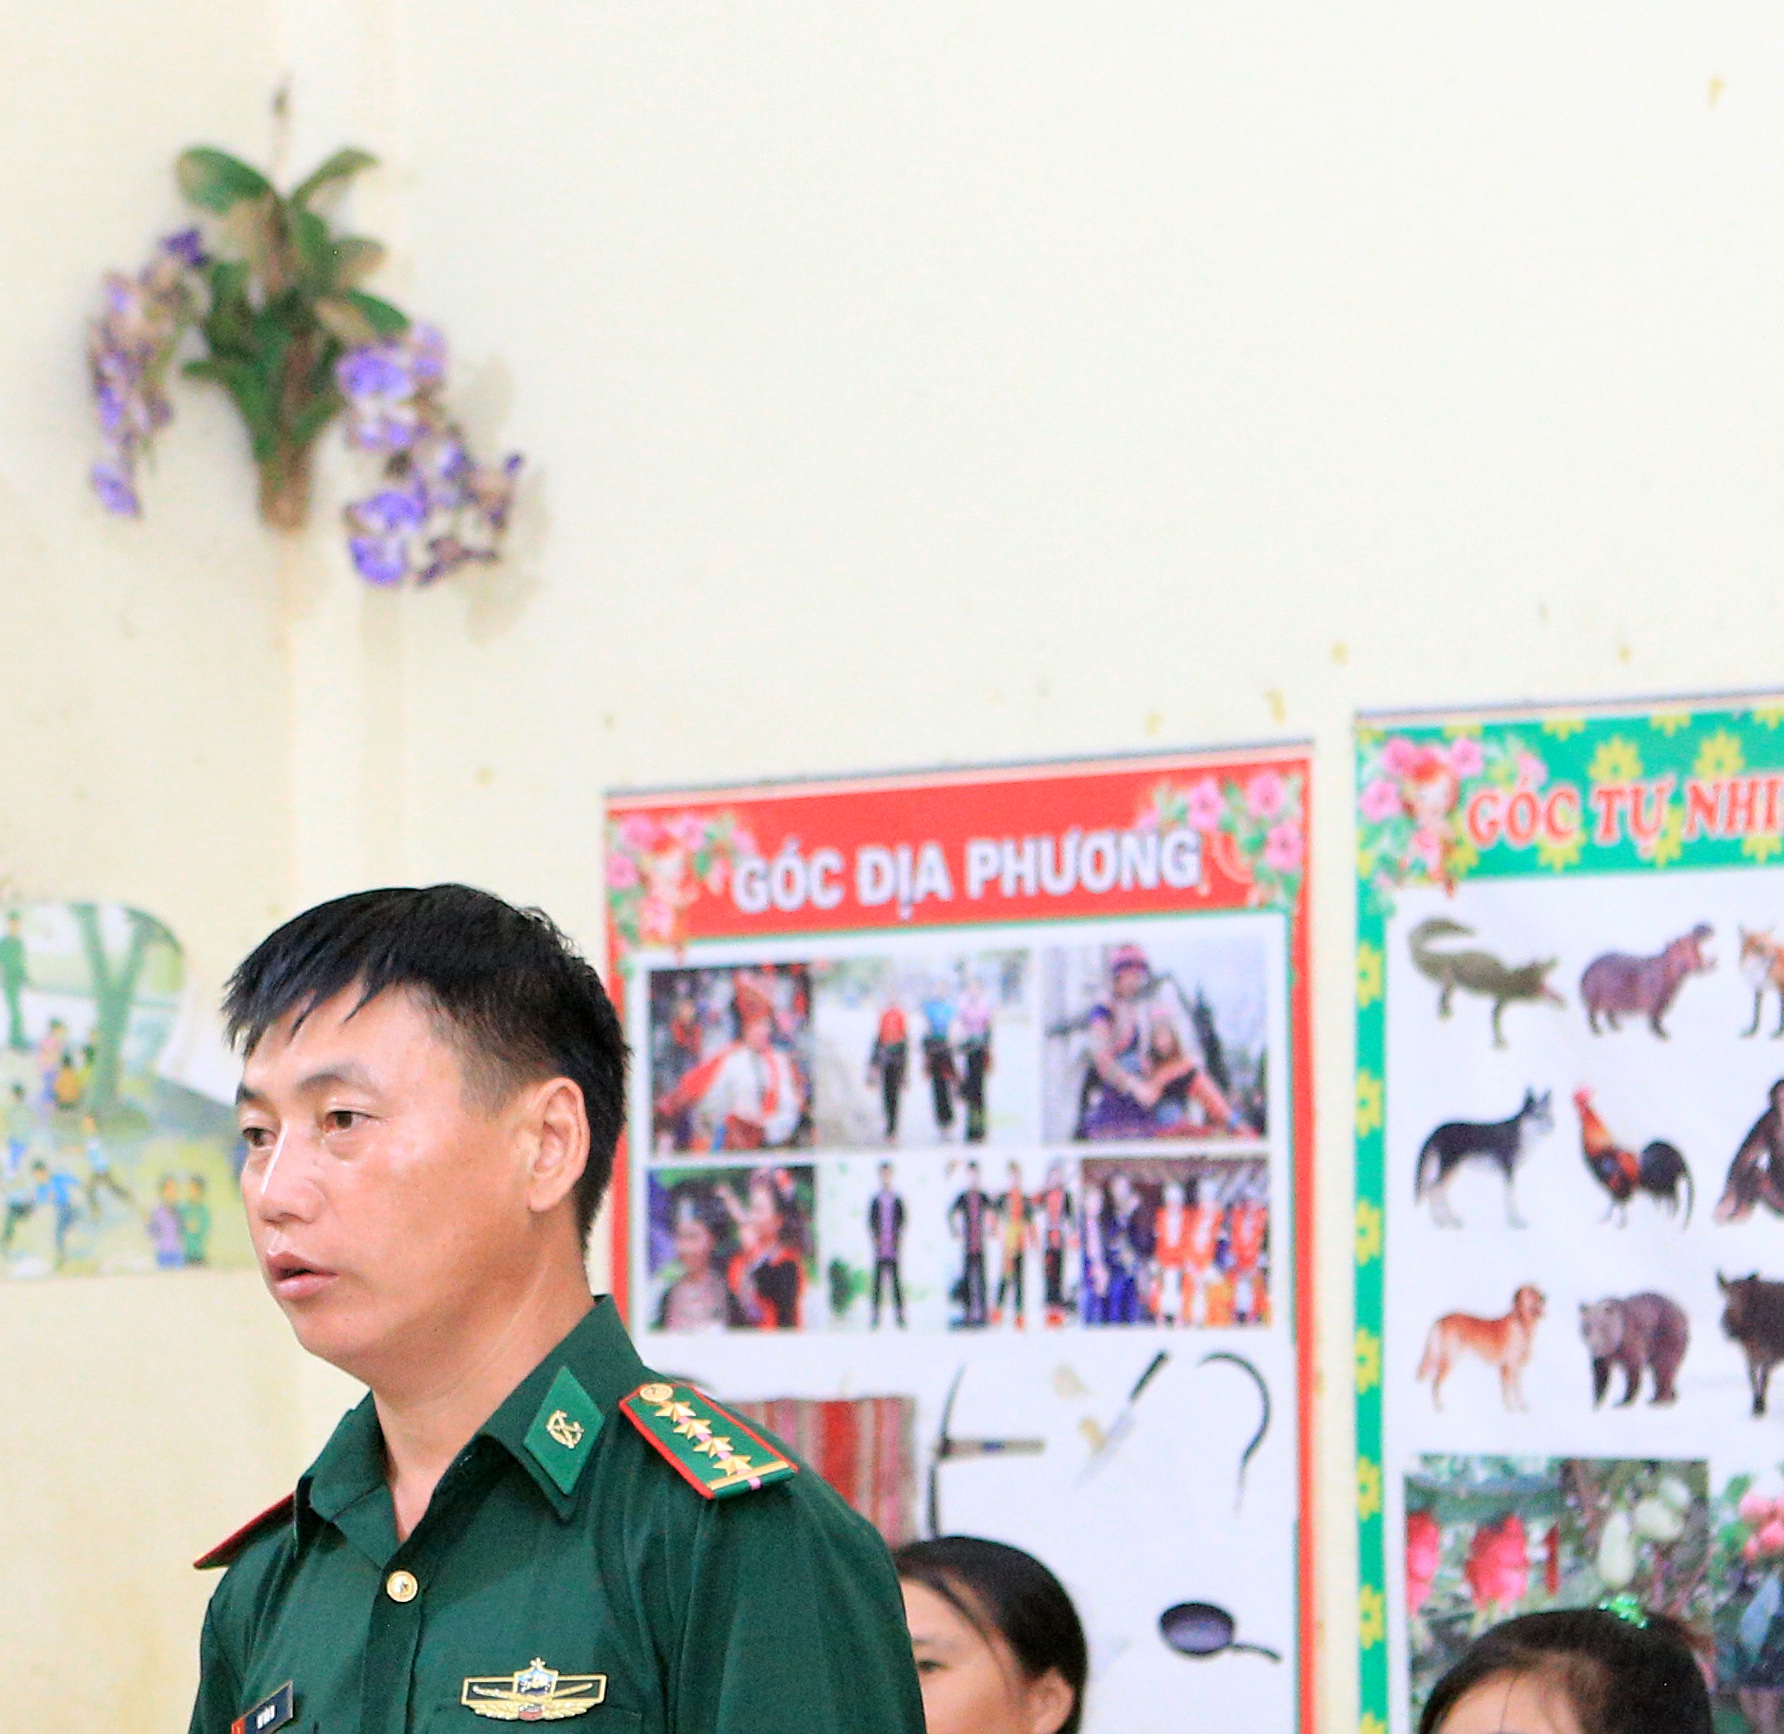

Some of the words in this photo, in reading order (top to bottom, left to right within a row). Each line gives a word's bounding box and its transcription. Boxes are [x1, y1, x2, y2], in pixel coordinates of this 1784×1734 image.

[1466, 774, 1579, 849] GÓC
[1593, 778, 1677, 858] TỰ
[733, 838, 845, 912] GÓC
[966, 824, 1201, 898] PHƯƠNG
